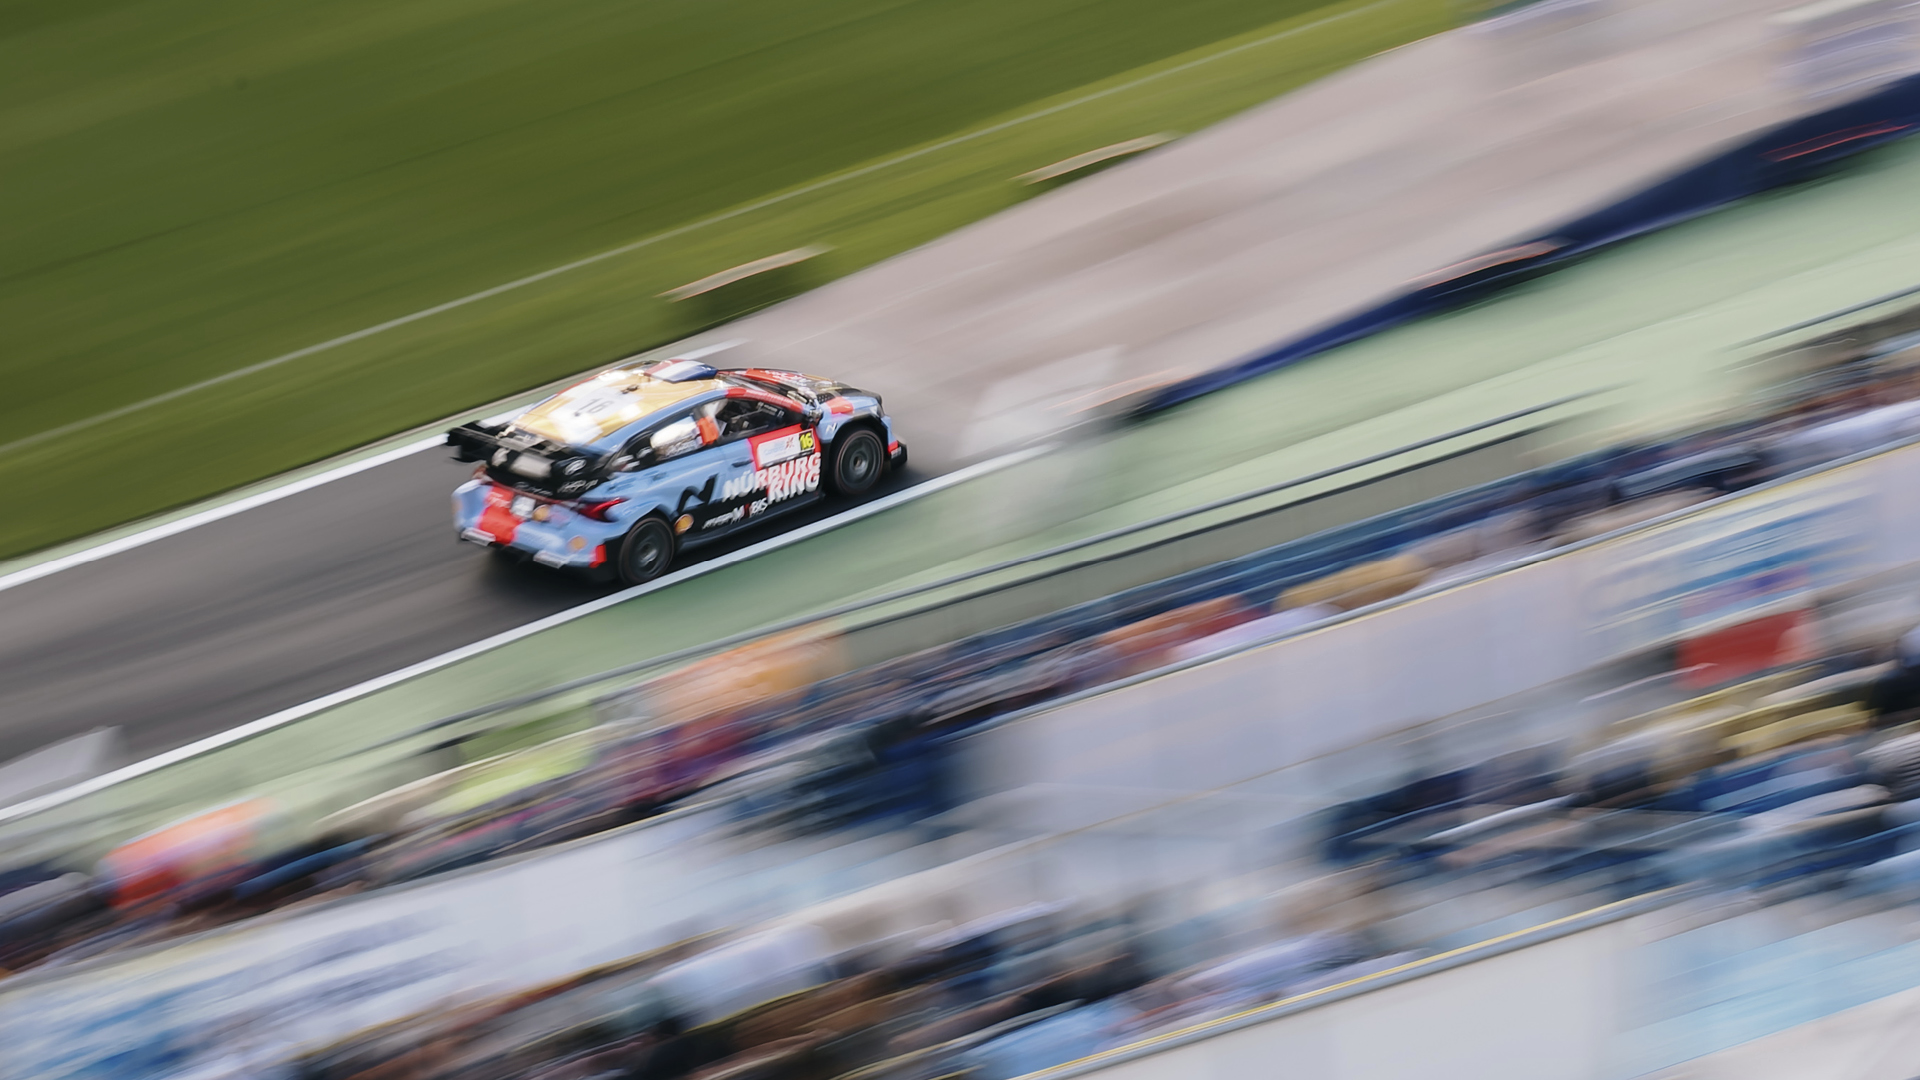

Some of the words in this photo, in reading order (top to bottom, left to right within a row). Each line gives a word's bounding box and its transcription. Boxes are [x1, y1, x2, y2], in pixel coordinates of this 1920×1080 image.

[799, 431, 814, 451] 16
[722, 452, 821, 503] NÜRBURG
[767, 468, 821, 505] RING
